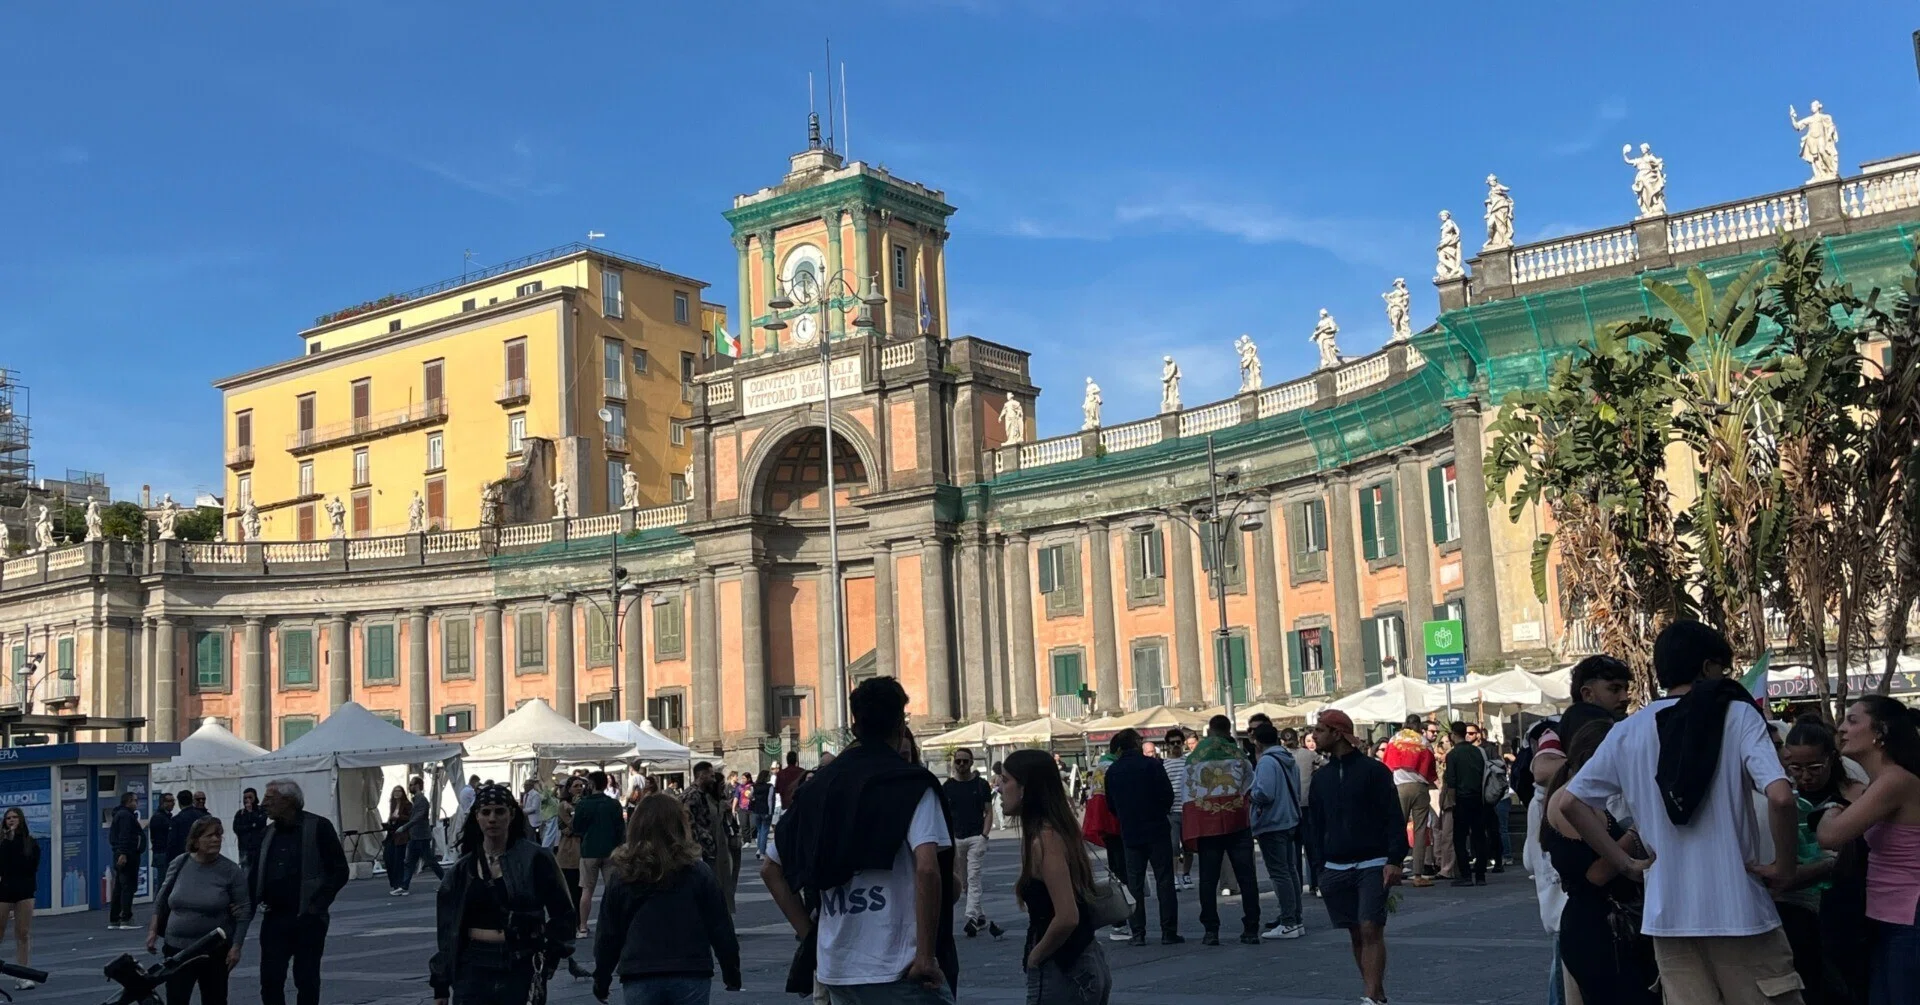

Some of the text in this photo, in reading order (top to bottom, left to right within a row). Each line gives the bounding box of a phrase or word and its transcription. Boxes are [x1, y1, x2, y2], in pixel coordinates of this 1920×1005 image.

[747, 374, 861, 409] VITTORIO EMAVELE
[750, 361, 854, 393] CONVITTO NAZINALE
[0, 793, 38, 805] NAPOLI
